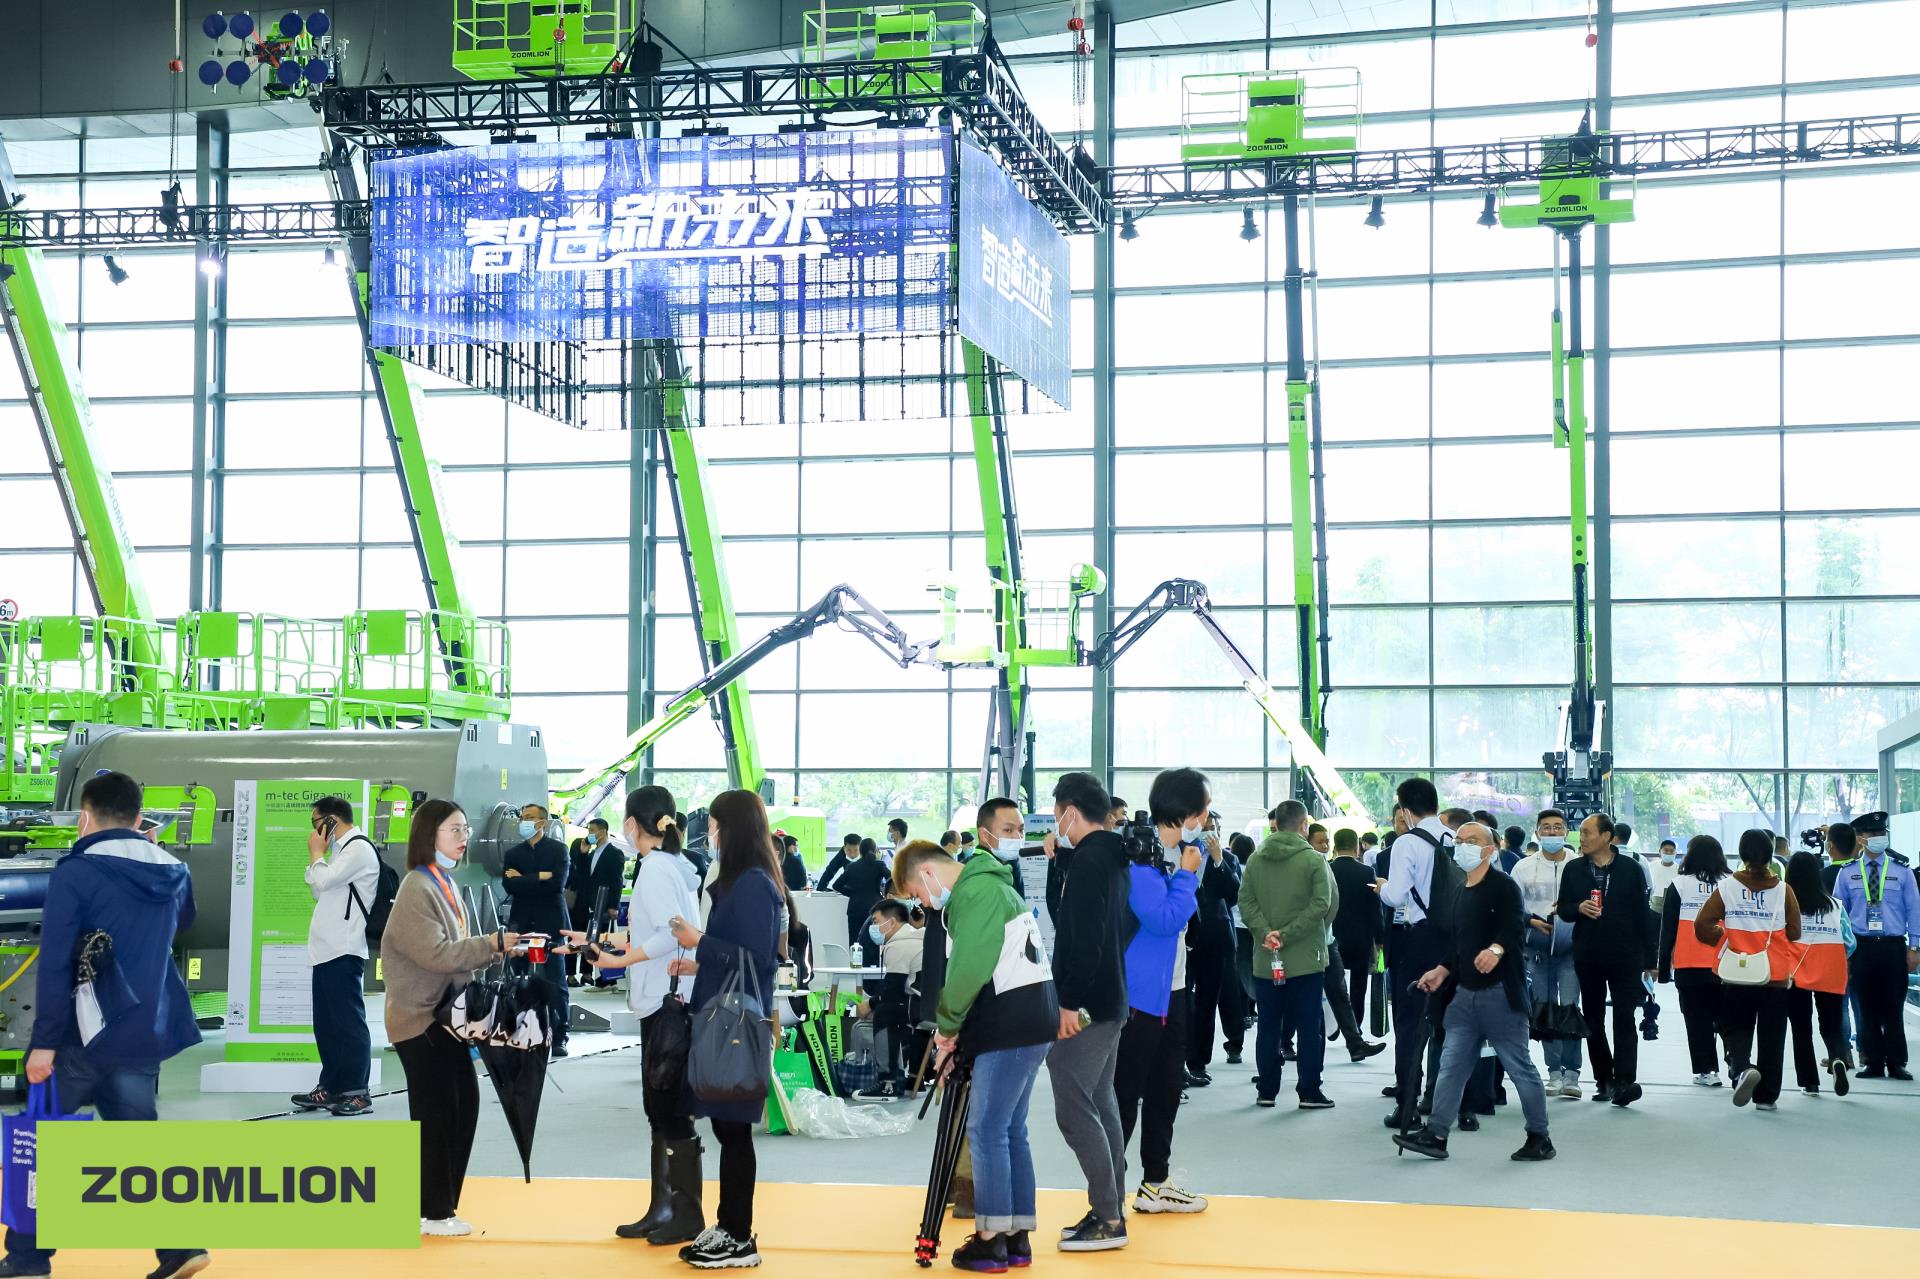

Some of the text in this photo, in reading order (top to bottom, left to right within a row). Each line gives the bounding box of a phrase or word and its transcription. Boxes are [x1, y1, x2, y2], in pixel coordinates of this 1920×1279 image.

[1545, 205, 1588, 213] ZOOMLION
[265, 790, 297, 800] m-tec
[236, 791, 249, 885] ZOOMLION
